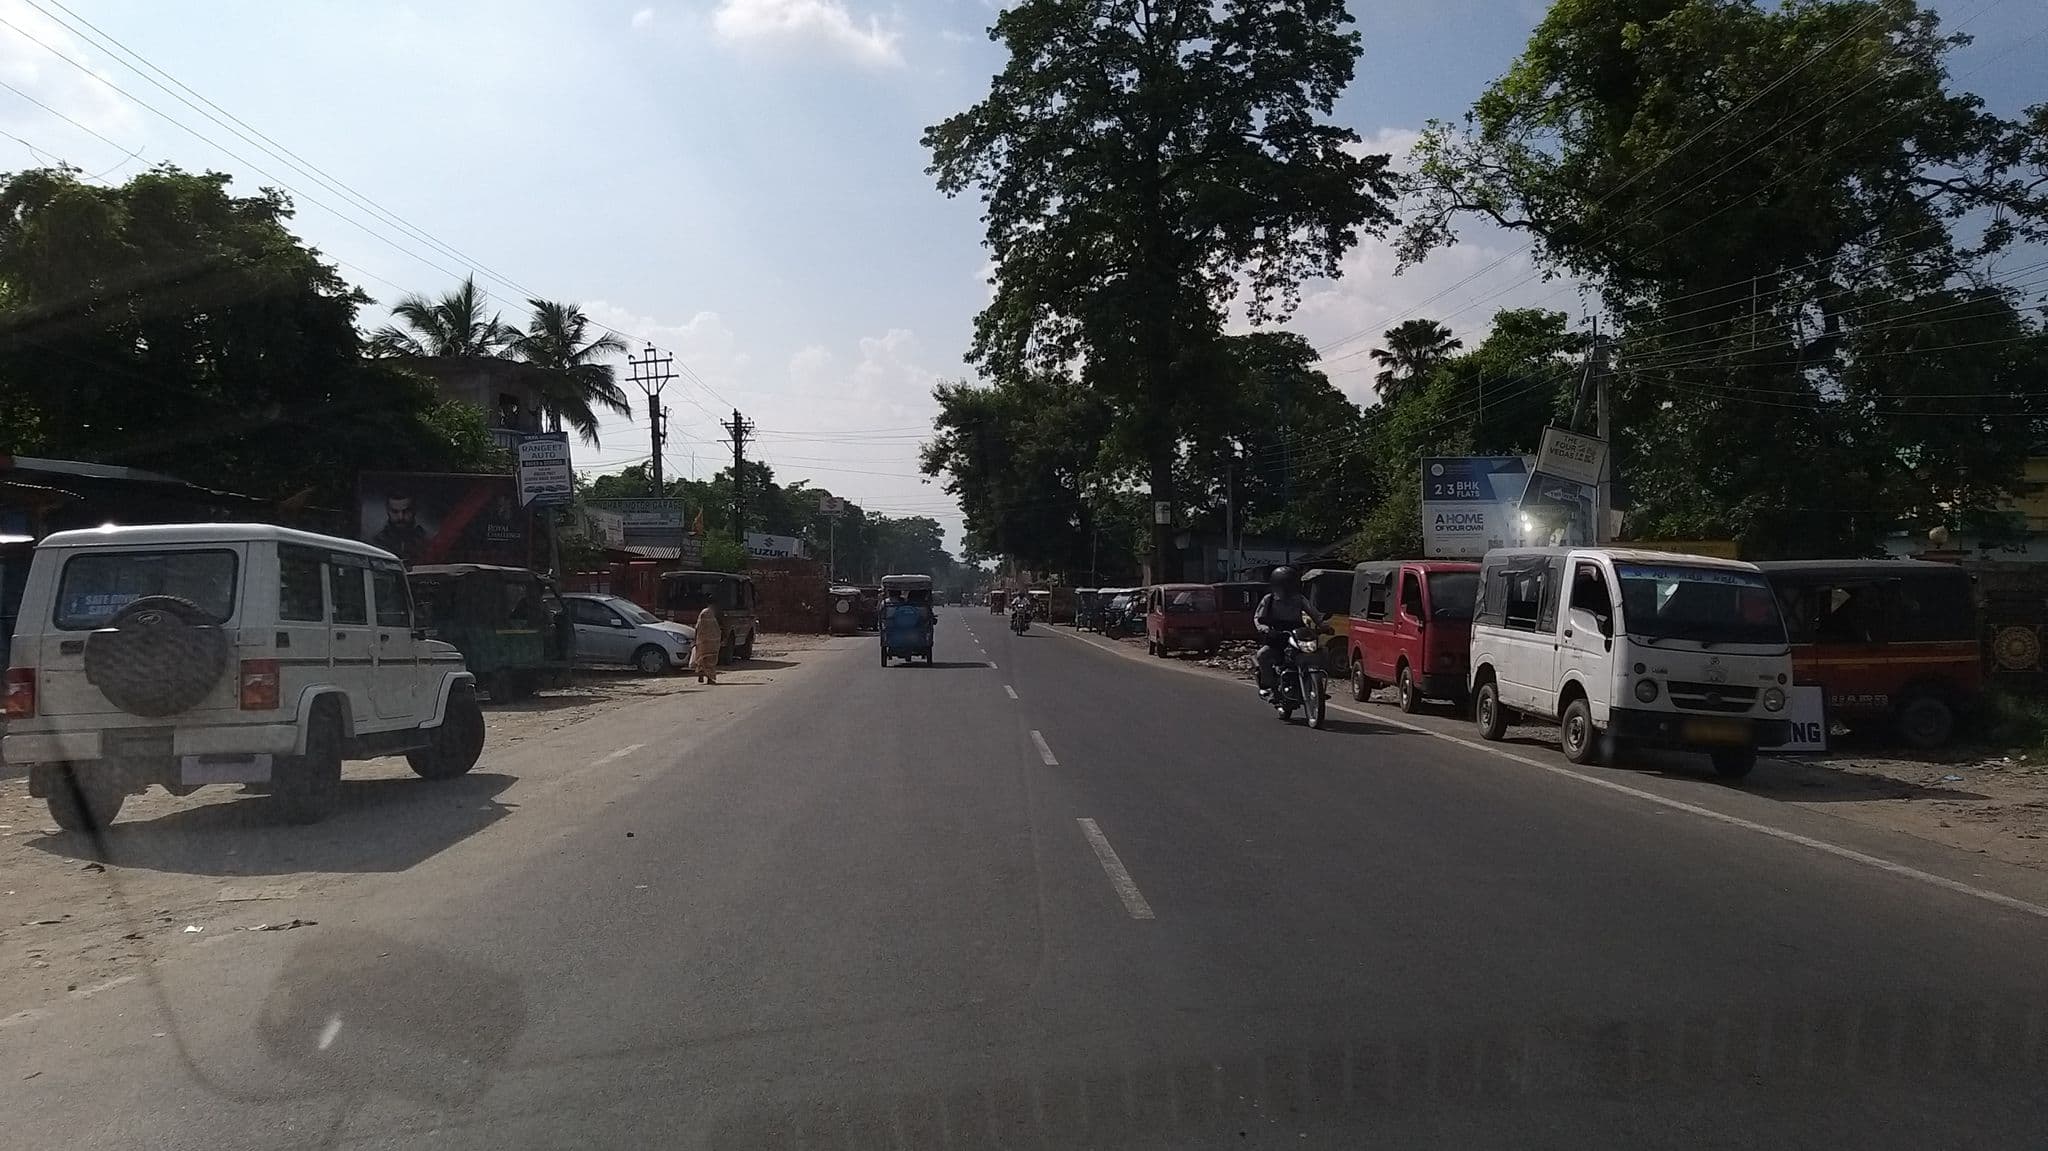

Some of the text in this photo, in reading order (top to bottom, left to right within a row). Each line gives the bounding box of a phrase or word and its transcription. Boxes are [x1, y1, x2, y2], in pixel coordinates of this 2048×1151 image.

[1563, 435, 1578, 444] THE
[1555, 441, 1577, 452] FOUR
[1549, 447, 1575, 459] VEDAS
[1456, 481, 1480, 490] BHK
[652, 501, 681, 510] GARAGE
[1435, 513, 1484, 524] A HOME
[748, 547, 789, 557] SUZUKI
